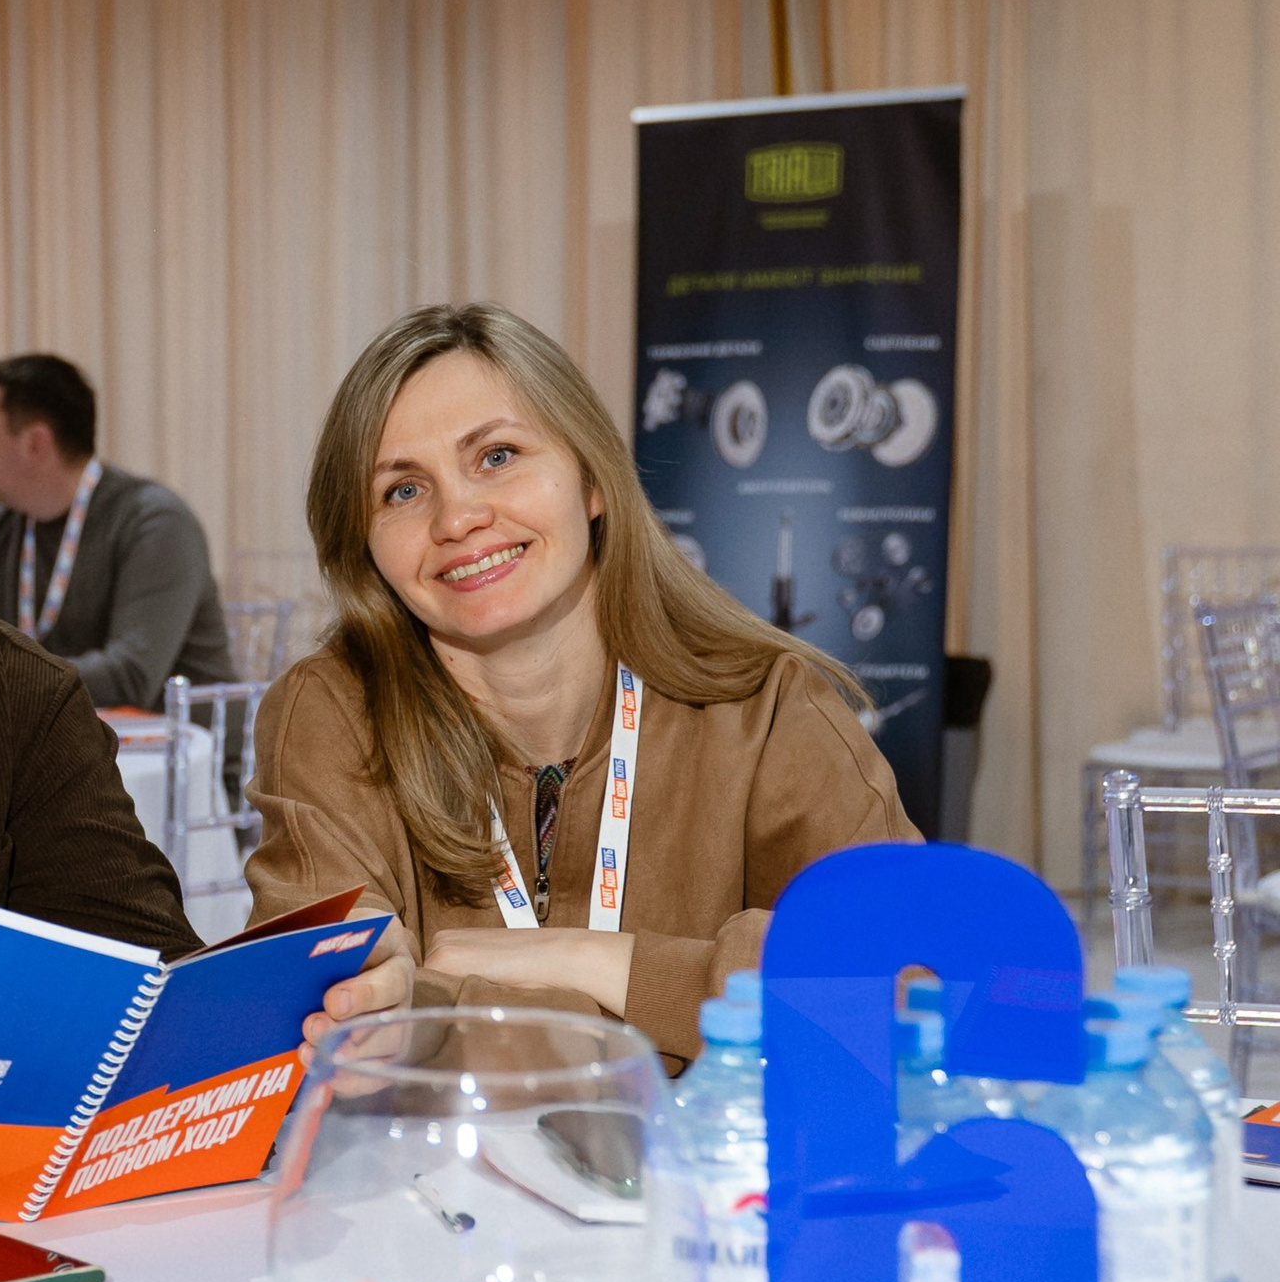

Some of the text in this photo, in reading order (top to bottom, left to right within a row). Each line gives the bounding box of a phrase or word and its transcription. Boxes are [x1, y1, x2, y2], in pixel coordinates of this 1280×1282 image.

[64, 1105, 256, 1200] ПОЛНОМ ХОДУ
[81, 1063, 295, 1164] ПОДДЕРЖИМ НА
